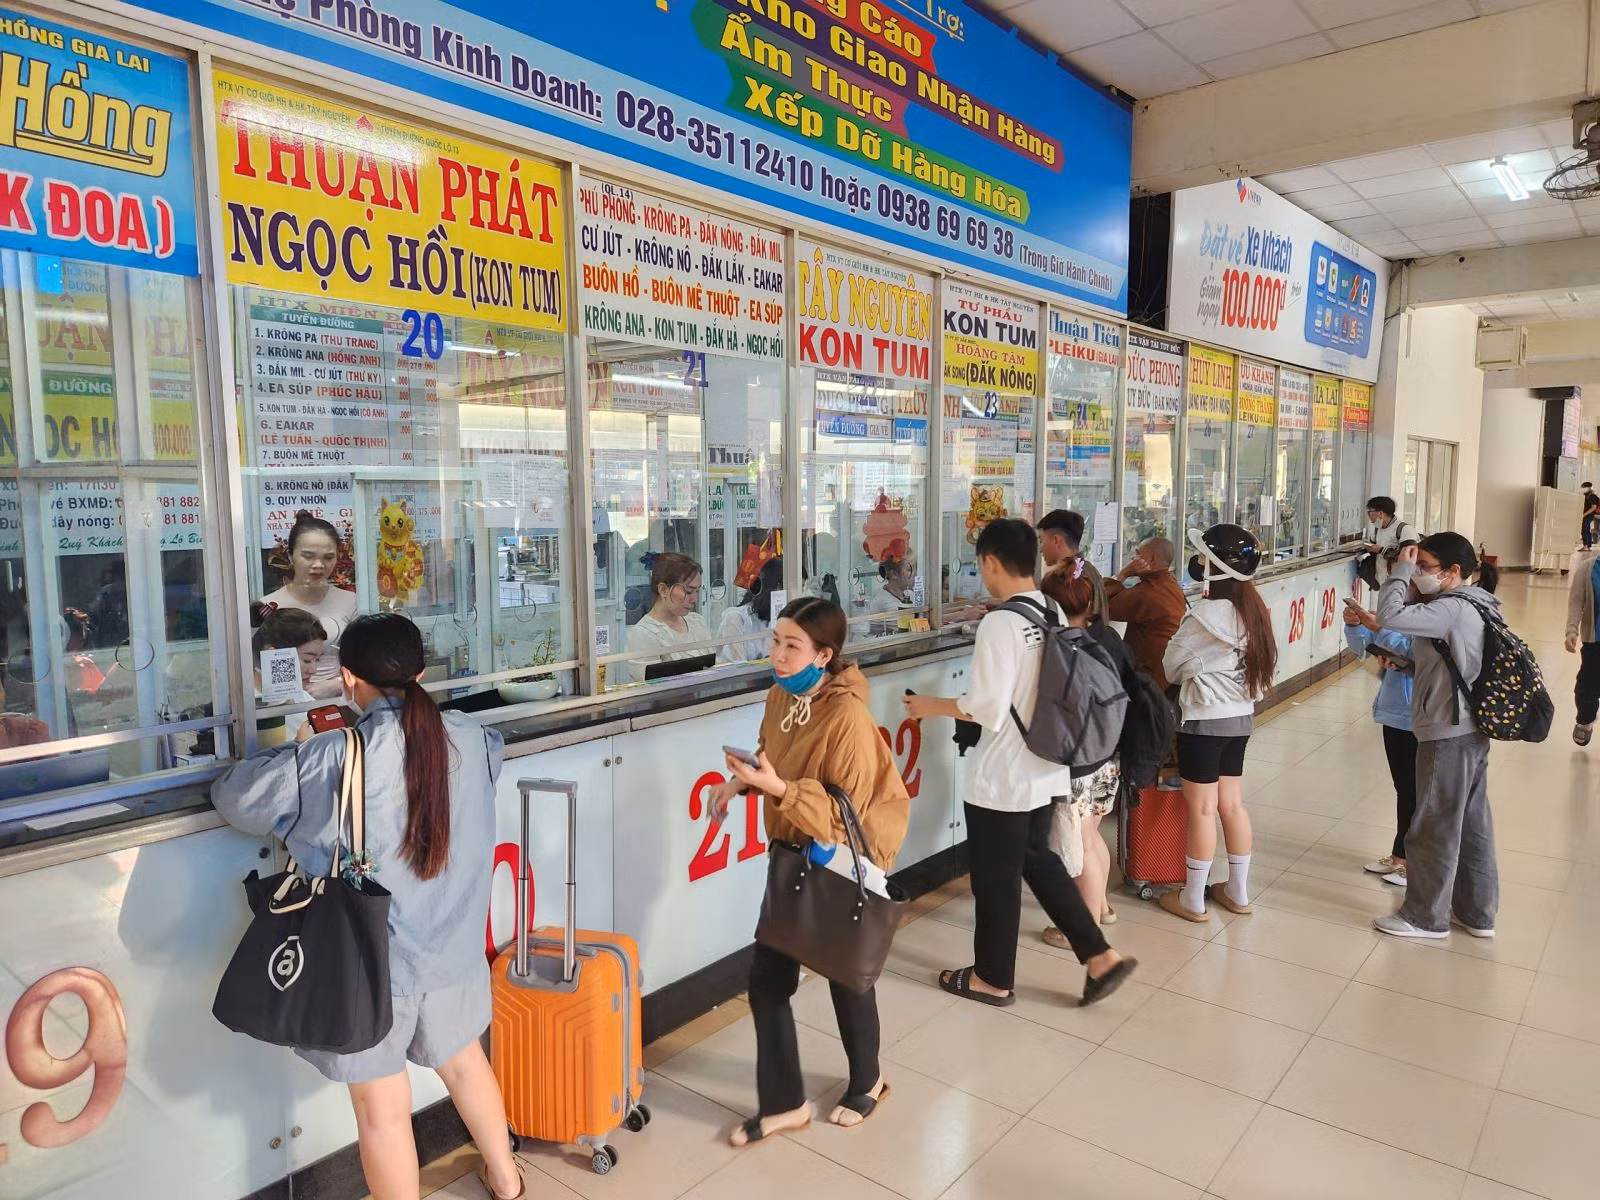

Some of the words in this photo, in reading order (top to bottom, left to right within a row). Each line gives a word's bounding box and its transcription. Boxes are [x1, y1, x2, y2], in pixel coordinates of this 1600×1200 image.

[860, 1, 922, 57] Cáo
[71, 38, 111, 63] GIA
[116, 50, 150, 73] LAI
[720, 12, 792, 78] Ẩm
[805, 57, 892, 123] Thực
[218, 79, 233, 92] HTX
[234, 85, 245, 96] VT
[276, 96, 287, 108] HH
[295, 100, 305, 112] HK
[829, 25, 906, 87] Giao
[917, 70, 990, 126] Nhận
[998, 112, 1056, 166] Hàng
[433, 25, 502, 84] Kinh
[511, 54, 602, 119] Doanh:
[616, 89, 814, 192] 028-35112410
[821, 166, 871, 213] hoặc
[881, 182, 930, 231] 0938
[937, 205, 960, 240] 69
[966, 216, 987, 250] 69
[993, 226, 1013, 258] 38
[1018, 244, 1048, 274] (Trong
[1066, 261, 1087, 285] Hành
[744, 75, 824, 138] Xếp
[836, 116, 882, 161] Dỡ
[892, 141, 966, 198] Hàng
[974, 175, 1022, 219] Hóa
[438, 156, 559, 244] PHÁT
[601, 183, 634, 199] (QL.14)
[643, 203, 677, 236] KRÔNG
[679, 216, 691, 240] PA
[700, 213, 718, 246] ĐẮK
[720, 223, 744, 254] NÔNG
[750, 228, 768, 260] ĐẮK
[769, 243, 783, 264] MIL
[227, 201, 373, 291] NGỌC
[387, 223, 466, 298] HỒI
[468, 250, 513, 311] (KON
[518, 264, 563, 324] TUM)
[581, 223, 600, 252] CƯ
[603, 225, 622, 257] JÚT
[634, 236, 674, 269] KRÔNG
[677, 245, 691, 273] NÔ
[701, 247, 722, 280] ĐẮK
[726, 253, 745, 285] LẮK
[754, 268, 783, 294] EAKAR
[1228, 231, 1245, 265] vé
[1245, 225, 1260, 267] Xe
[1260, 230, 1293, 274] khách
[257, 296, 309, 310] HTX
[583, 261, 619, 295] BUÔN
[622, 265, 640, 298] HỒ
[651, 276, 683, 307] BUÔN
[687, 283, 703, 311] MÊ
[706, 289, 740, 321] THUỘT
[749, 299, 762, 322] EA
[765, 298, 783, 325] SÚP
[799, 247, 845, 324] TÂY
[848, 273, 933, 341] NGUYÊN
[949, 285, 962, 294] HTX
[964, 288, 972, 297] VT
[974, 291, 983, 299] HH
[990, 296, 999, 304] HK
[958, 299, 981, 312] TƯ
[282, 312, 317, 325] TUYẾN
[320, 316, 355, 329] ĐƯỜNG
[402, 309, 444, 360] 20
[584, 301, 622, 333] KRÔNG
[625, 312, 645, 337] ANA
[655, 317, 675, 340] KON
[677, 322, 697, 345] TUM
[706, 318, 725, 350] ĐẮK
[727, 325, 738, 351] HÀ
[747, 334, 768, 359] NGỌC
[770, 330, 783, 359] HỒI
[944, 309, 989, 339] KON
[995, 321, 1036, 349] TUM
[255, 328, 264, 338] 1.
[267, 327, 302, 341] KRÔNG
[305, 333, 317, 343] PA
[320, 335, 343, 346] (THU
[345, 337, 379, 350] TRANG)
[799, 322, 862, 370] KON
[872, 337, 929, 381] TUM
[1160, 342, 1169, 351] TUY
[256, 345, 265, 356] 2.
[268, 345, 303, 359] KRÔNG
[305, 350, 325, 361] ANA
[359, 354, 381, 367] ANH)
[956, 343, 998, 360] HOÀNG
[1002, 352, 1025, 365] TÂM
[257, 364, 265, 375] 3.
[268, 361, 287, 377] ĐẮK
[290, 366, 306, 378] MIL
[314, 367, 326, 379] CƯ
[328, 367, 343, 380] JÚT
[682, 350, 709, 388] 21
[952, 364, 966, 380] SONG
[966, 360, 997, 387] (ĐẮK
[1000, 365, 1037, 396] NÔNG)
[1149, 359, 1180, 388] PHONG
[1212, 363, 1232, 390] LINH
[257, 382, 266, 393] 4.
[268, 383, 285, 393] EA
[288, 383, 312, 395] SÚP
[317, 385, 352, 398] (PHÚC
[356, 387, 382, 401] HẬU)
[985, 392, 998, 418] 23
[282, 404, 297, 414] TUM
[260, 420, 271, 430] 6.
[276, 421, 314, 431] EAKAR
[322, 433, 350, 447] QUỐC
[353, 436, 387, 448] THỊNH)
[262, 451, 271, 460] 7.
[274, 449, 298, 460] BUÔN
[318, 449, 345, 461] THUỘT
[264, 481, 273, 490] 8.
[277, 479, 309, 490] KRÔNG
[311, 480, 323, 490] NÔ
[68, 497, 113, 510] BXMĐ:
[180, 496, 200, 507] 882
[265, 496, 275, 506] 9.
[278, 496, 297, 506] QUY
[301, 494, 327, 505] NHƠN
[77, 514, 115, 530] nóng:
[268, 510, 287, 520] AN
[87, 535, 124, 548] Khách
[1288, 597, 1305, 644] 28
[1321, 586, 1336, 629] 29
[688, 770, 767, 883] 21
